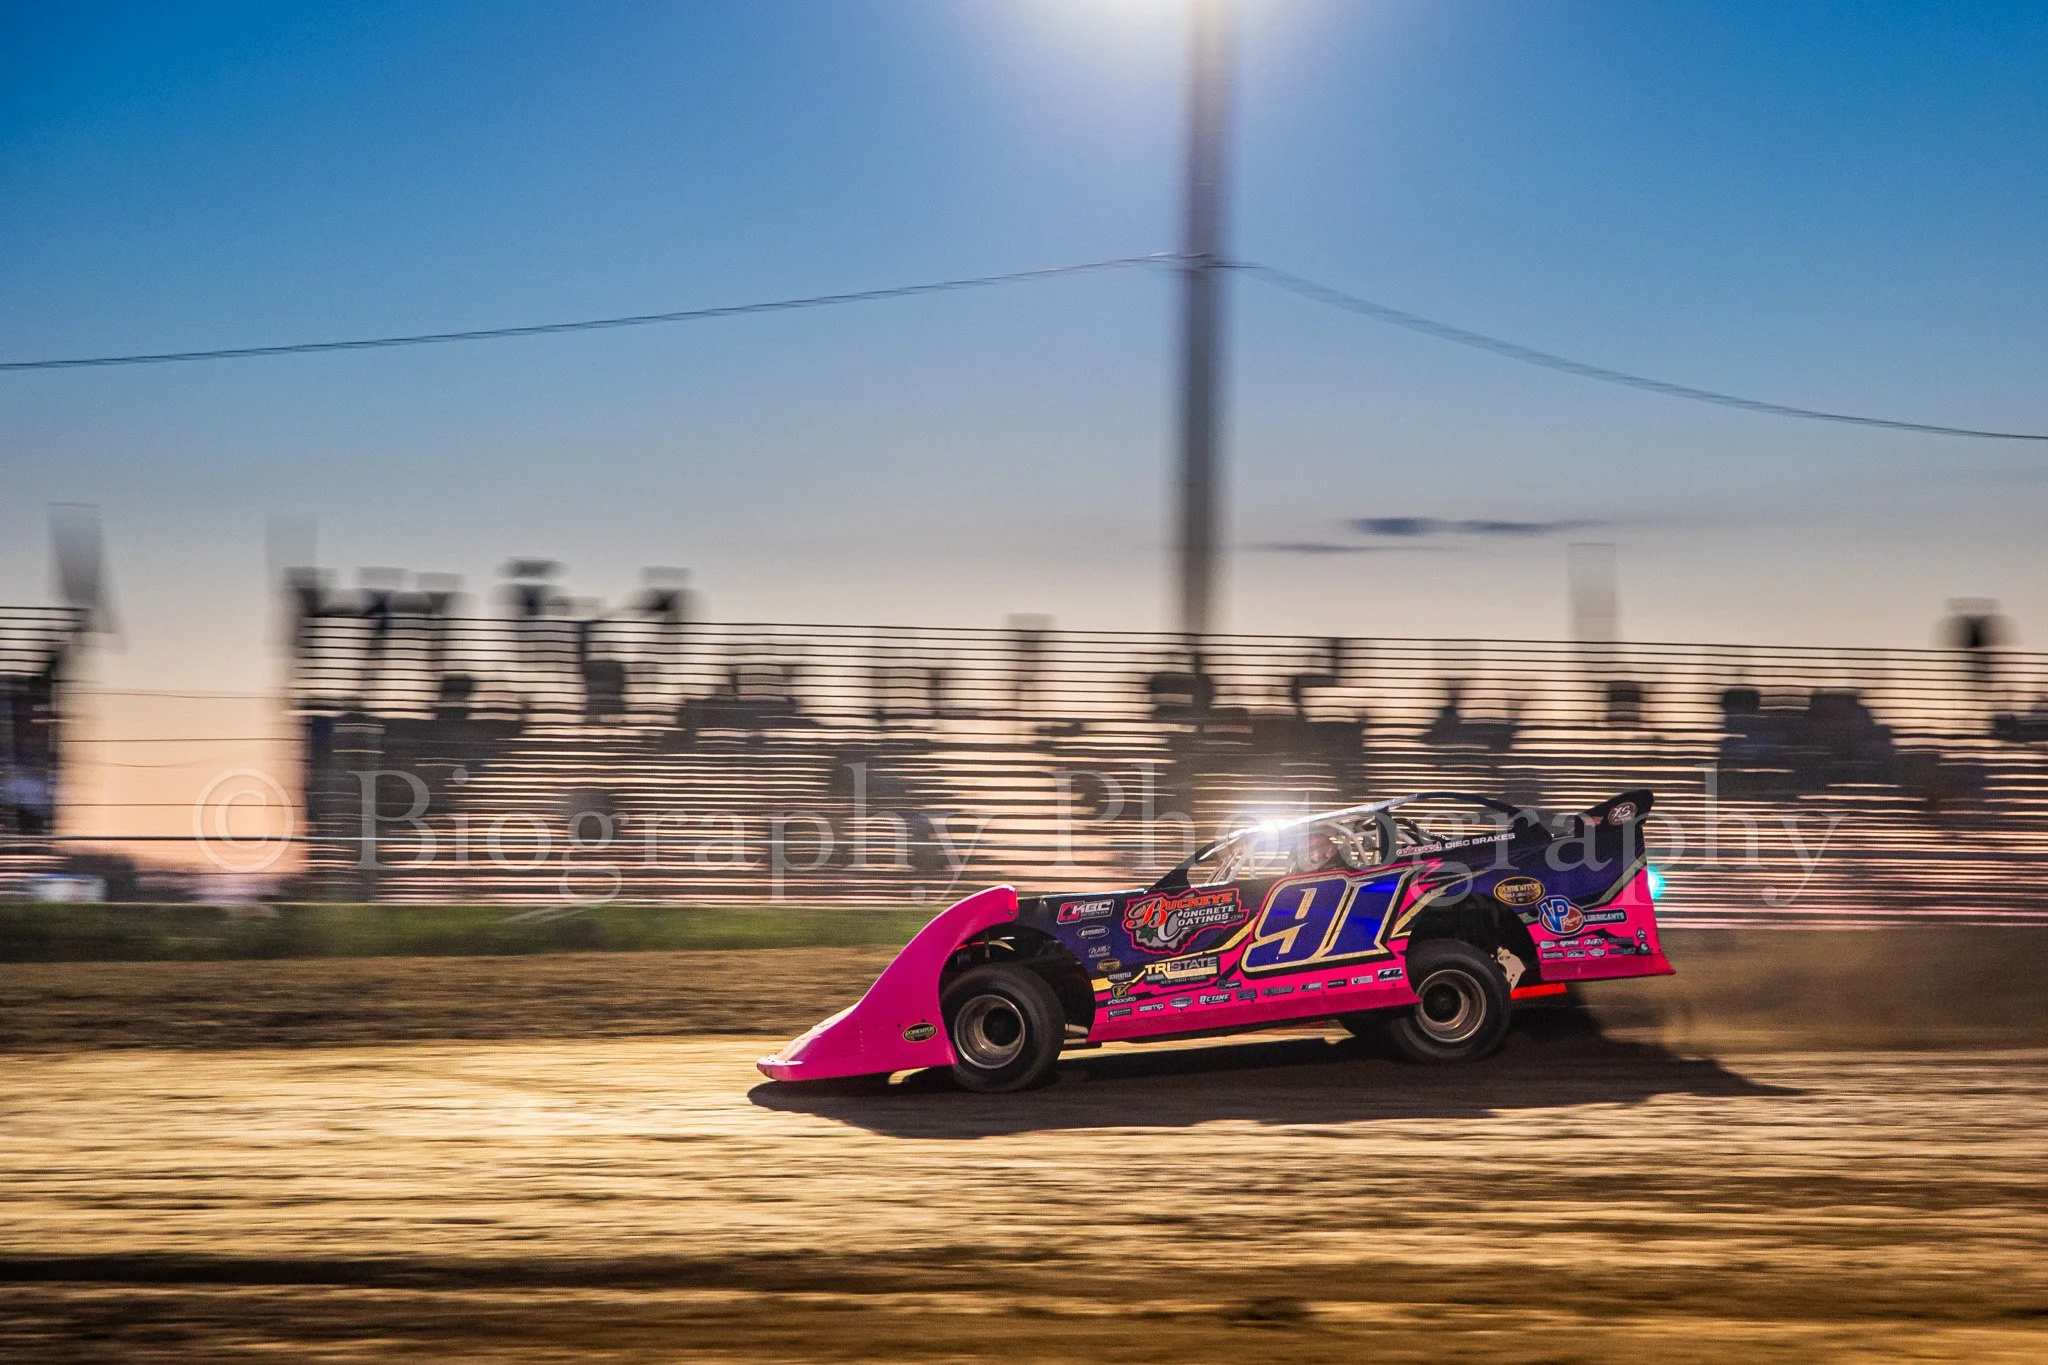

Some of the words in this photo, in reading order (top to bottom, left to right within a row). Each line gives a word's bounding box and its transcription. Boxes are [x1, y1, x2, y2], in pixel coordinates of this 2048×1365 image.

[1445, 840, 1471, 849] DISC
[1472, 832, 1516, 845] BRAKES
[1126, 893, 1233, 928] BUCKEYE
[1240, 872, 1418, 974] 91
[1540, 899, 1569, 932] VP
[1583, 911, 1625, 922] LUBRICANTS
[1145, 956, 1217, 975] TRISTATE
